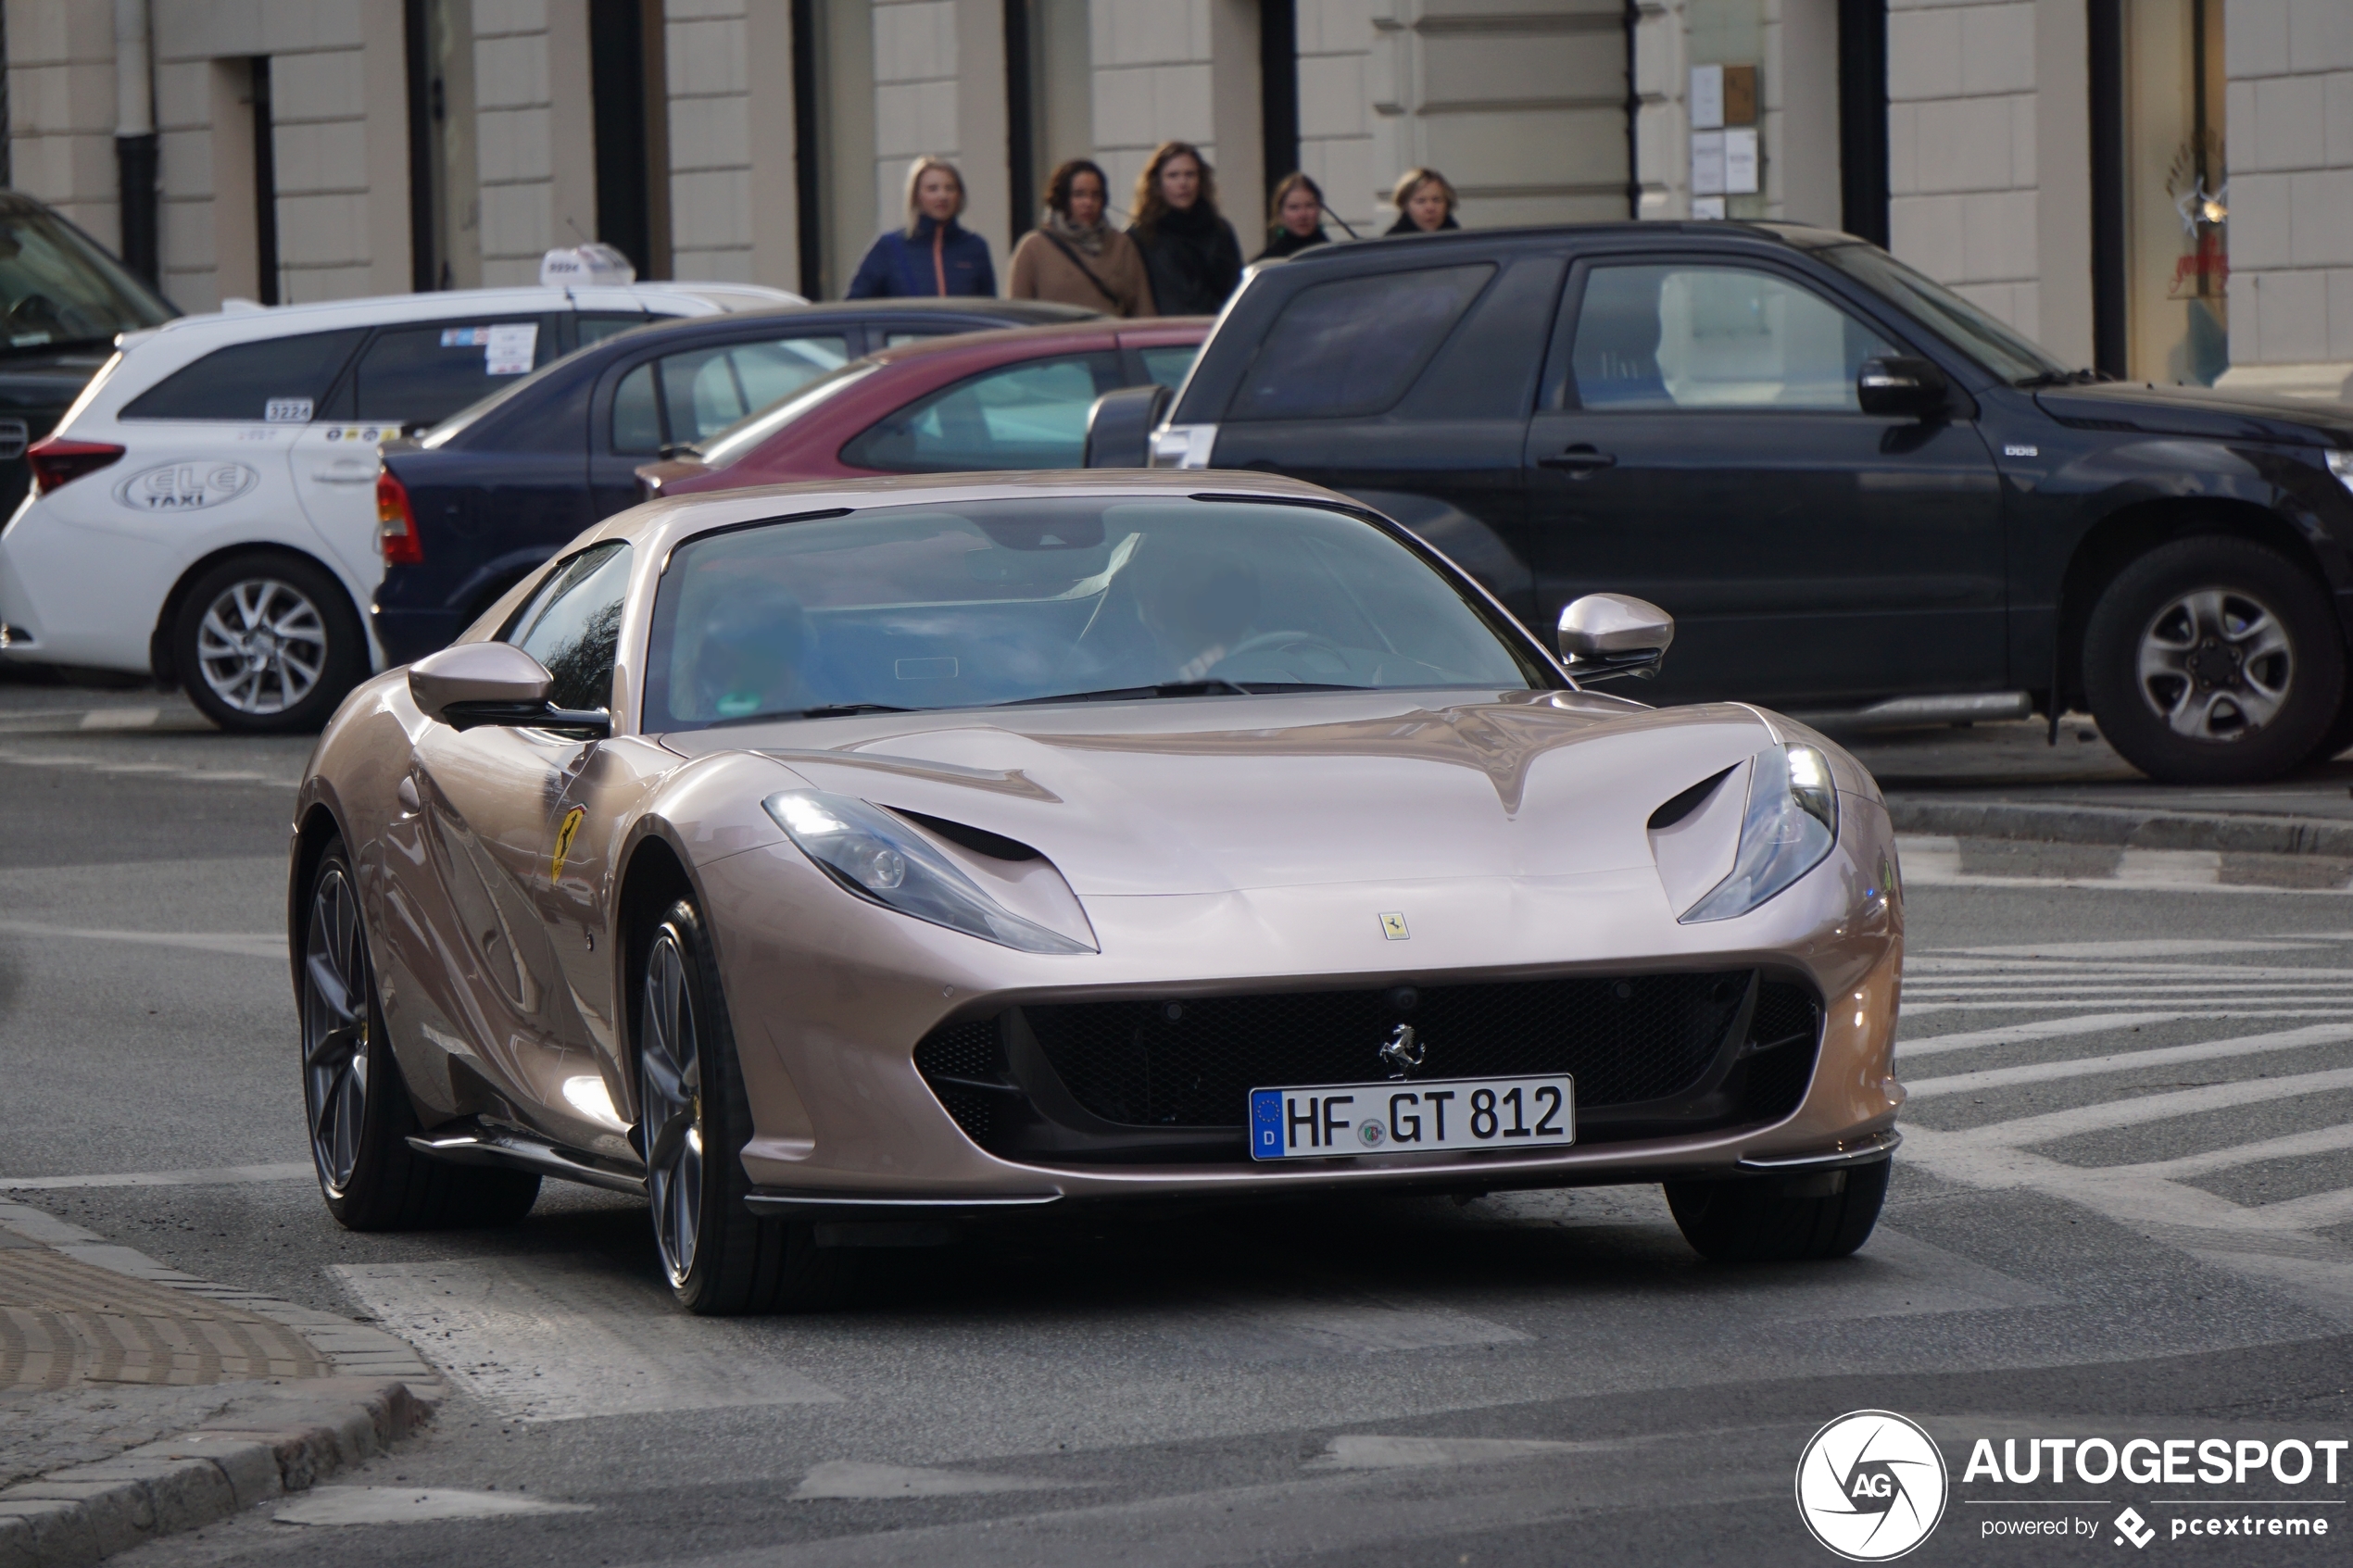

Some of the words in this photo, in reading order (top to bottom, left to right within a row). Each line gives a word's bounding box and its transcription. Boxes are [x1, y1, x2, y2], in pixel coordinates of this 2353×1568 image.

[270, 403, 310, 419] 3224
[145, 466, 238, 495] ELE
[147, 495, 204, 508] TAXI
[1288, 1096, 1353, 1148] HF
[1390, 1091, 1454, 1143] GT
[1470, 1085, 1564, 1139] 812
[1263, 1131, 1275, 1146] D
